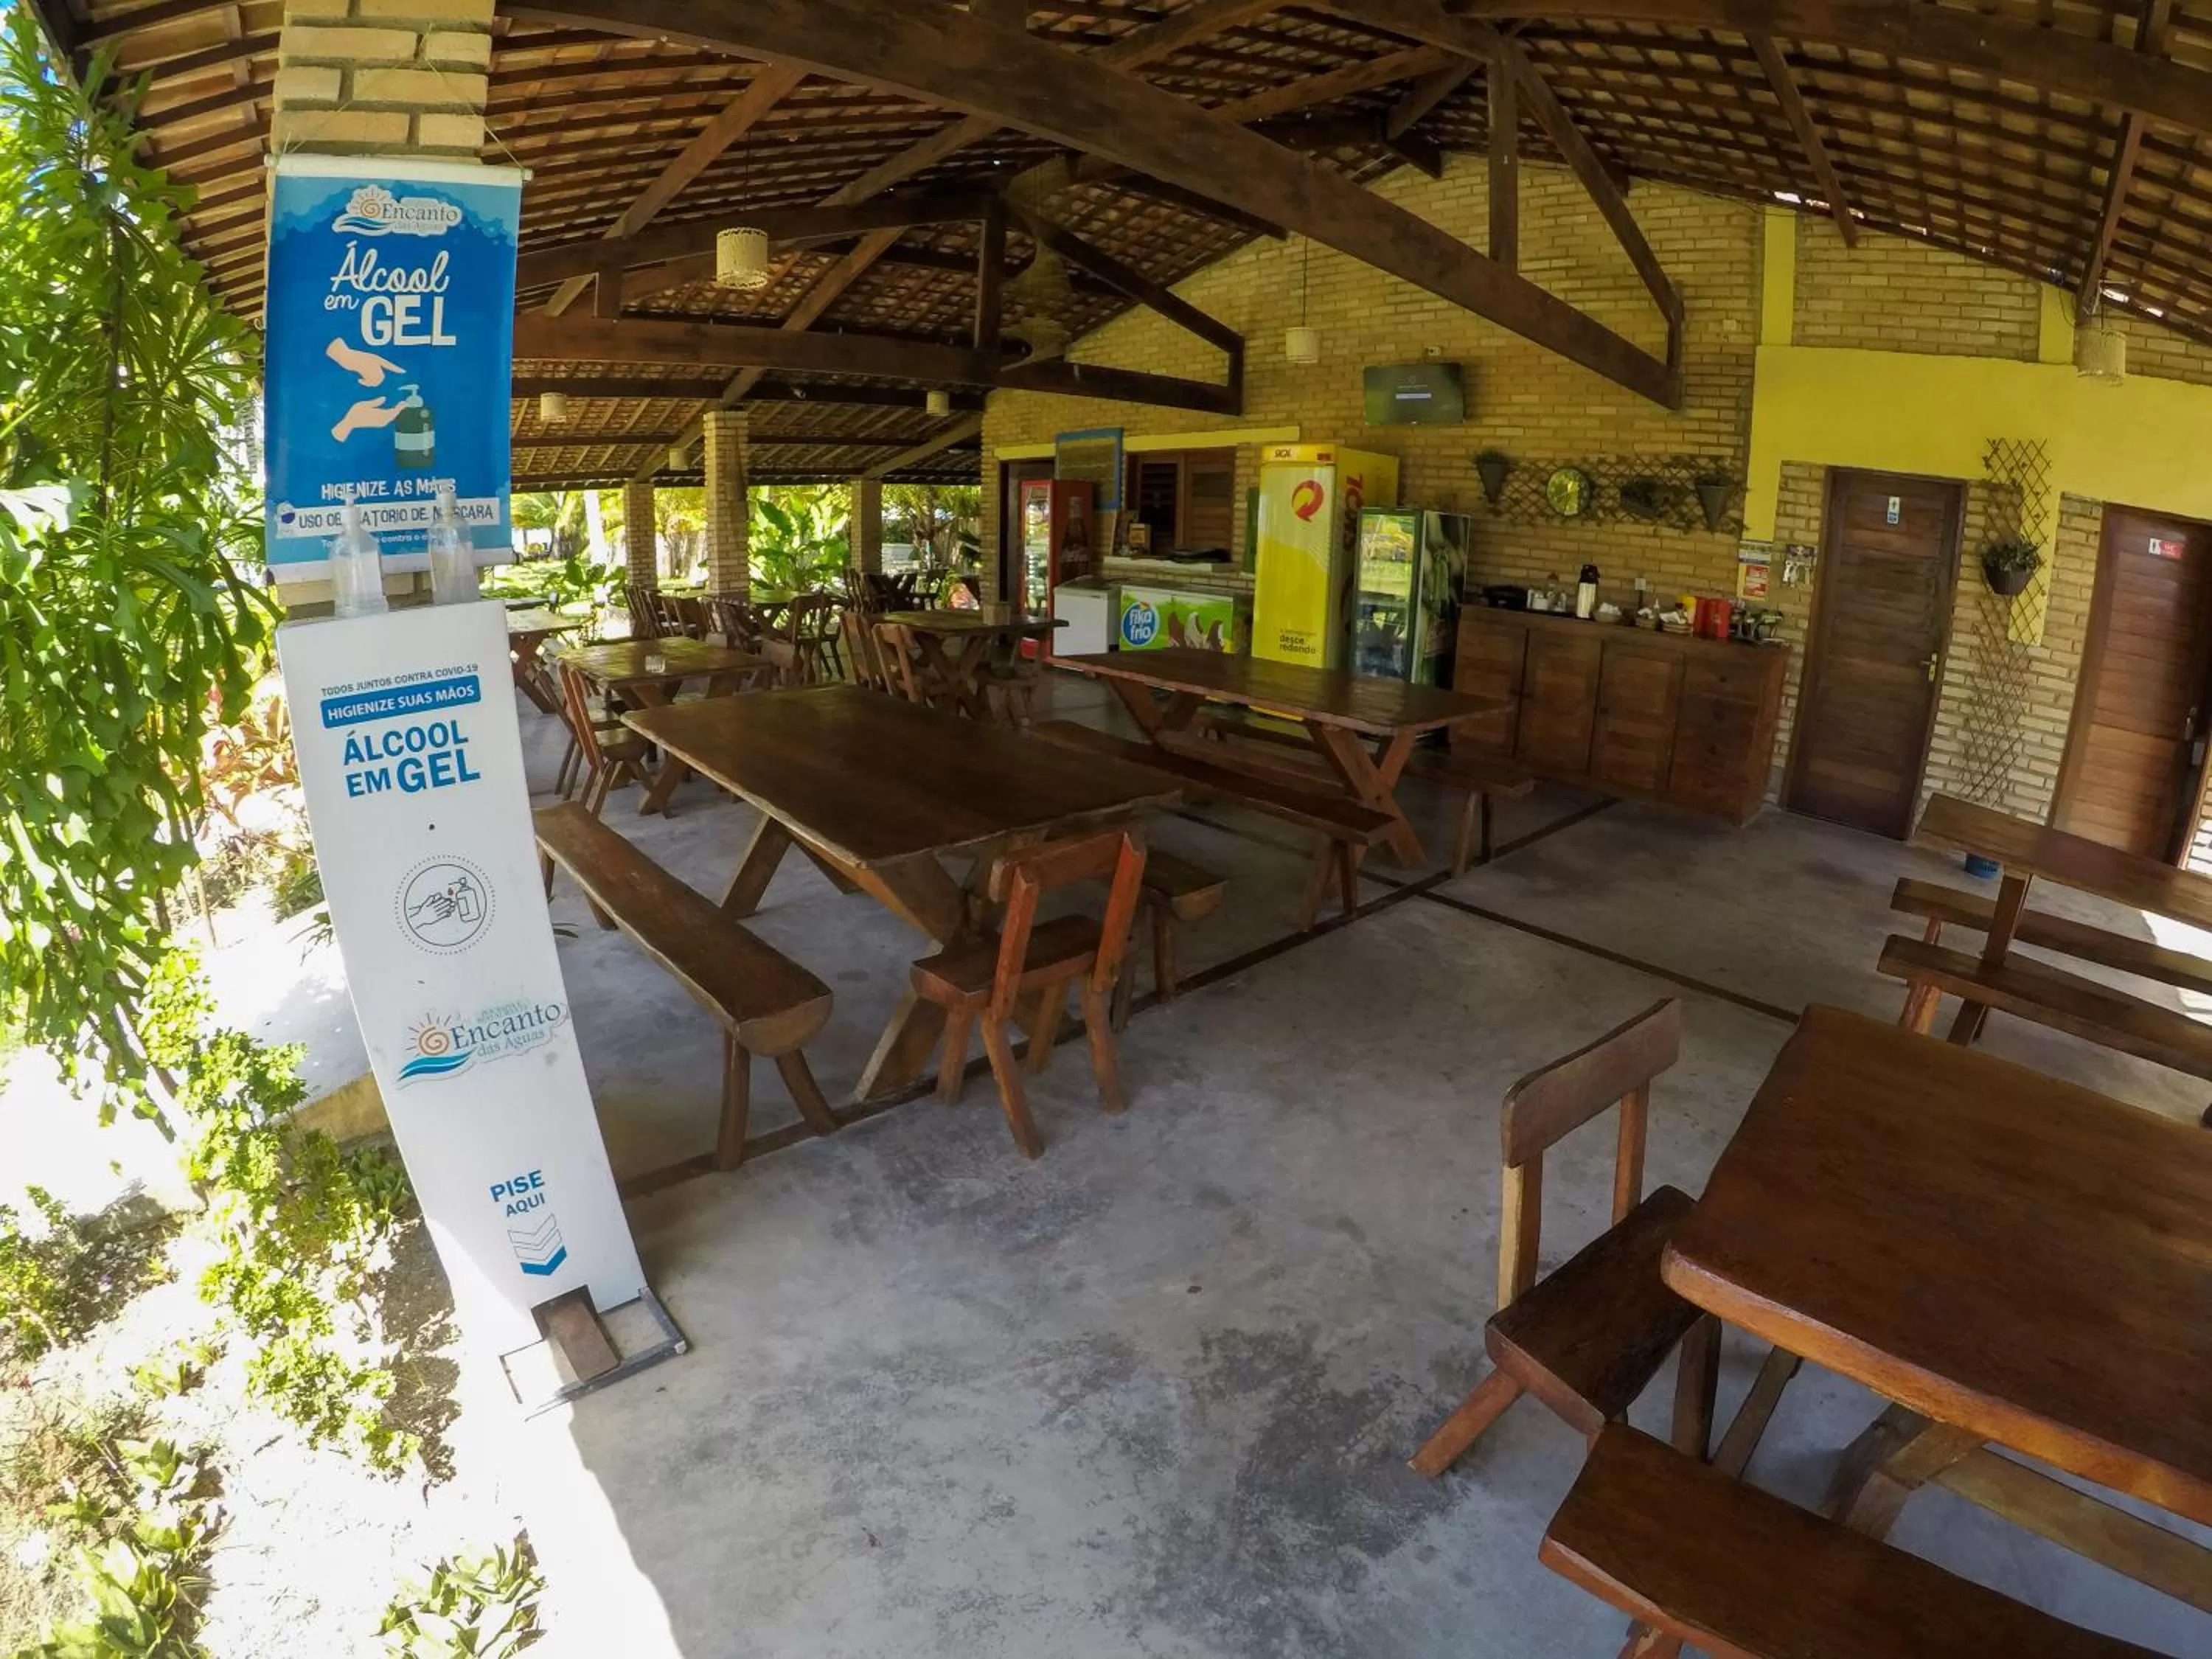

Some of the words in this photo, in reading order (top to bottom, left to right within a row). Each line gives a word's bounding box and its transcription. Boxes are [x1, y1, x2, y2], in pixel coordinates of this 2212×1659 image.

[382, 203, 459, 222] Encanto
[330, 240, 450, 293] Álcool
[324, 294, 360, 310] em
[361, 295, 456, 347] GEL
[321, 480, 390, 501] HIGIENIZE
[394, 479, 413, 498] AS
[299, 514, 323, 529] USO
[411, 509, 428, 522] DE
[433, 504, 493, 520] MSCARA
[321, 683, 354, 697] TODOS
[356, 676, 393, 692] JUNTOS
[395, 670, 433, 684] CONTRA
[435, 664, 479, 678] COVID-19
[327, 699, 396, 720] HIGIENIZE
[398, 692, 433, 709] SUAS
[435, 685, 475, 702] MÃOS
[343, 720, 469, 765] ÁLCOOL
[345, 768, 392, 798] EM
[396, 748, 481, 793] GEL
[451, 1004, 561, 1050] Encanto
[490, 1169, 545, 1203] PISE
[506, 1193, 546, 1217] AQUI
